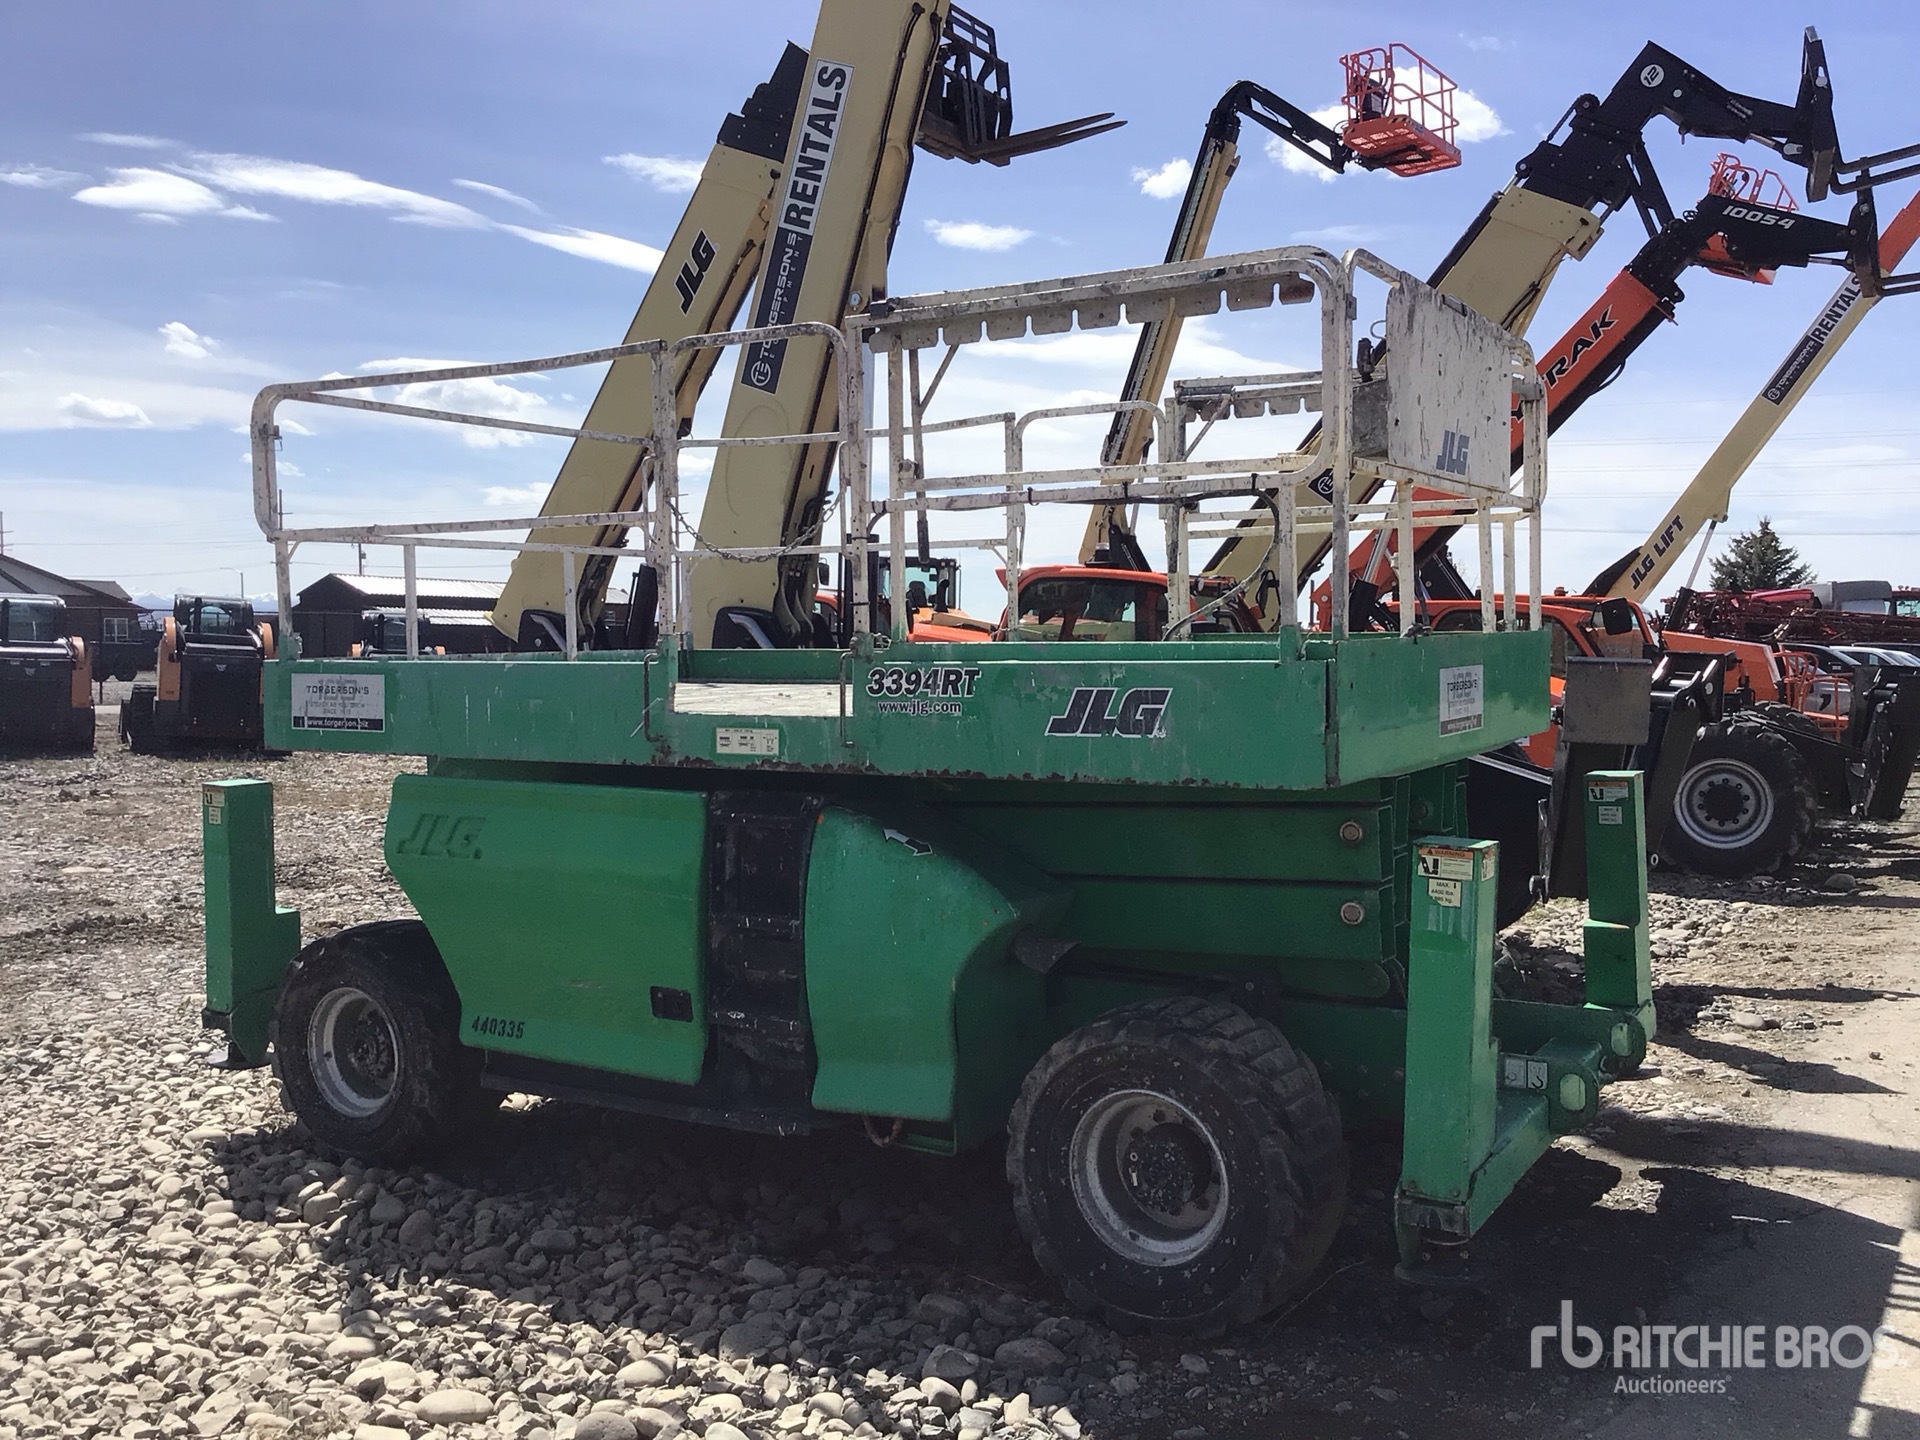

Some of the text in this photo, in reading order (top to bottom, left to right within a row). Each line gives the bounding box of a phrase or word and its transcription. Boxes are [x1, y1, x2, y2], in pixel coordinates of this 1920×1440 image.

[784, 66, 847, 230] RENTALS
[1722, 204, 1796, 230] 10054
[674, 228, 717, 317] JLG
[1541, 303, 1619, 389] RAK
[1436, 429, 1470, 476] JLG
[1630, 514, 1684, 591] JLG LIFT
[306, 685, 370, 695] TORGERSON'S
[866, 667, 981, 698] 3394RT
[878, 700, 962, 716] www.jlg.com
[1044, 687, 1174, 738] JLG
[396, 812, 487, 860] JLG
[471, 1015, 526, 1040] 440335
